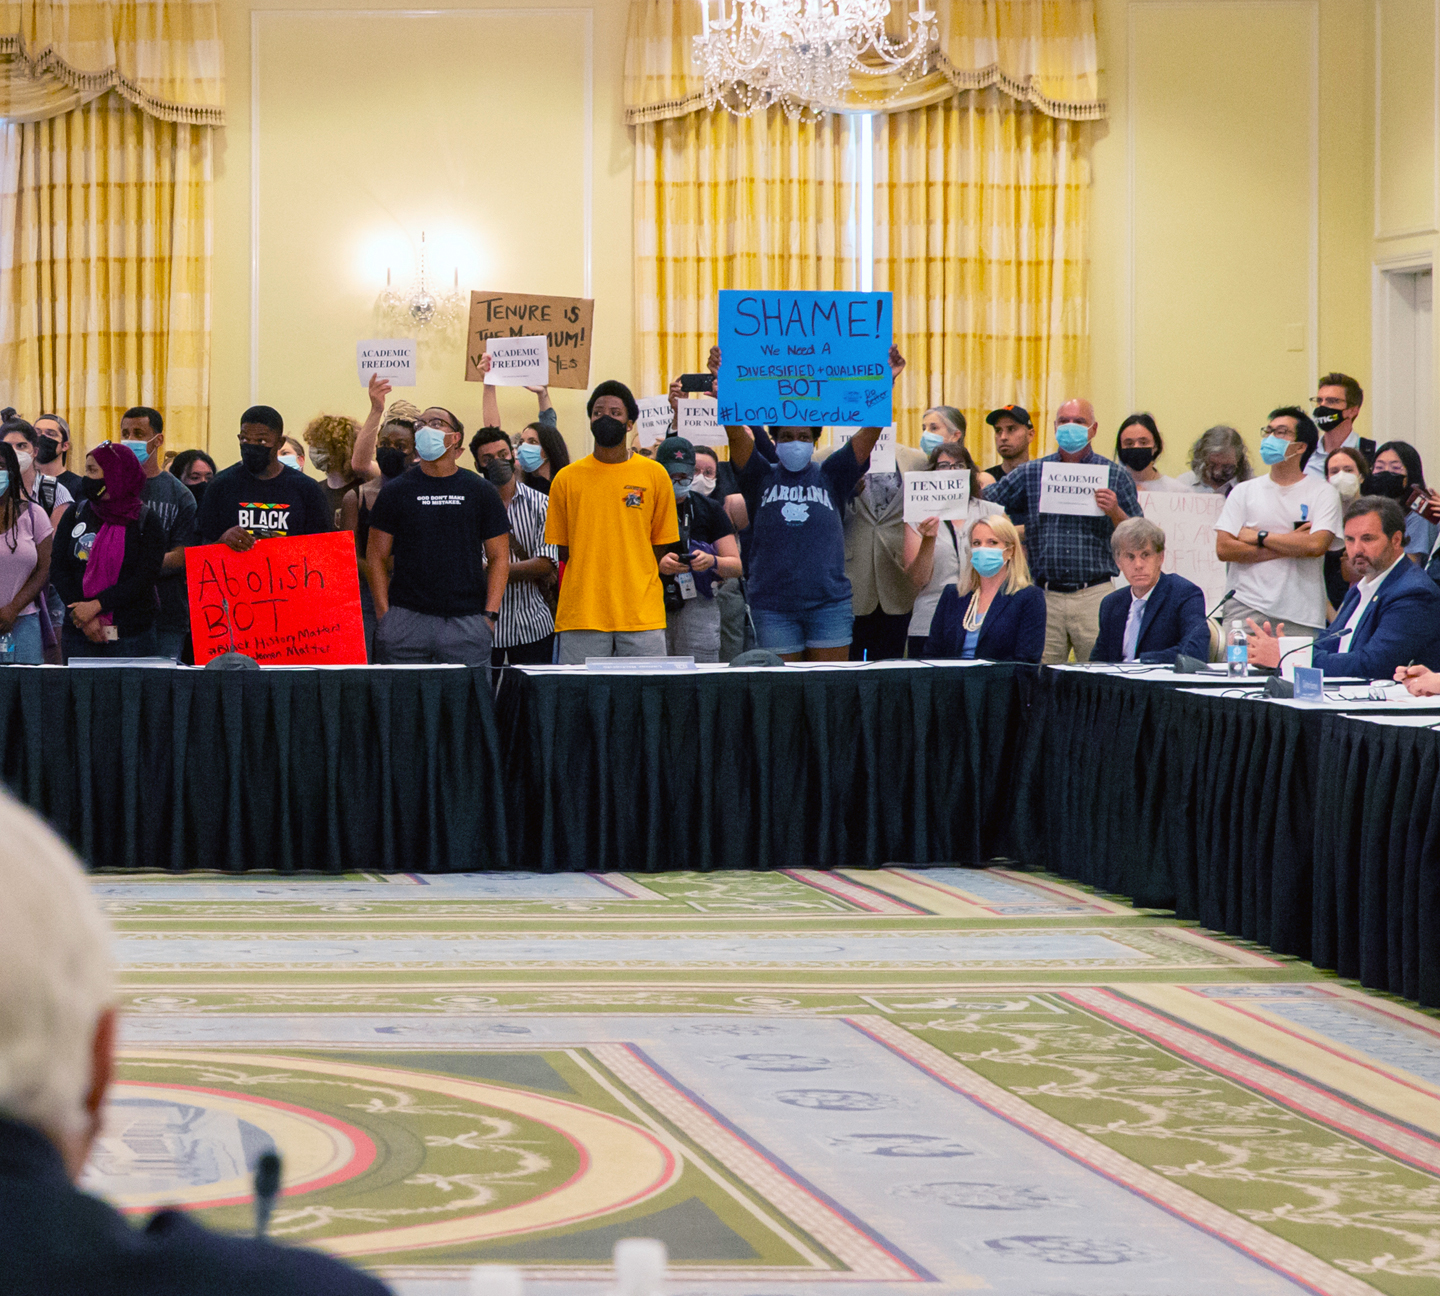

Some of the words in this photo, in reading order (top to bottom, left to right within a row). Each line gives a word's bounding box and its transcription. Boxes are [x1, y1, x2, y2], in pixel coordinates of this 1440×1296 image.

[478, 297, 552, 322] TENURE
[735, 297, 883, 339] SHAME!
[362, 349, 411, 358] ACADEMIC
[492, 348, 540, 358] ACADEMIC
[761, 344, 780, 356] We
[788, 344, 815, 356] Need
[822, 342, 831, 355] A
[362, 360, 410, 369] FREEDOM
[492, 359, 540, 369] FREEDOM
[738, 364, 814, 378] DIVERSIFIED
[826, 363, 884, 377] QUALIFIED
[779, 378, 828, 397] BOT
[641, 406, 674, 418] TENUR
[685, 407, 718, 417] TENU
[911, 478, 964, 491] TENURE
[1049, 473, 1103, 484] ACADEMIC
[911, 494, 929, 502] FOR
[932, 493, 964, 502] NIKOLE
[239, 510, 290, 530] BLACK
[199, 557, 325, 602] Abolish
[202, 599, 288, 639] BOT
